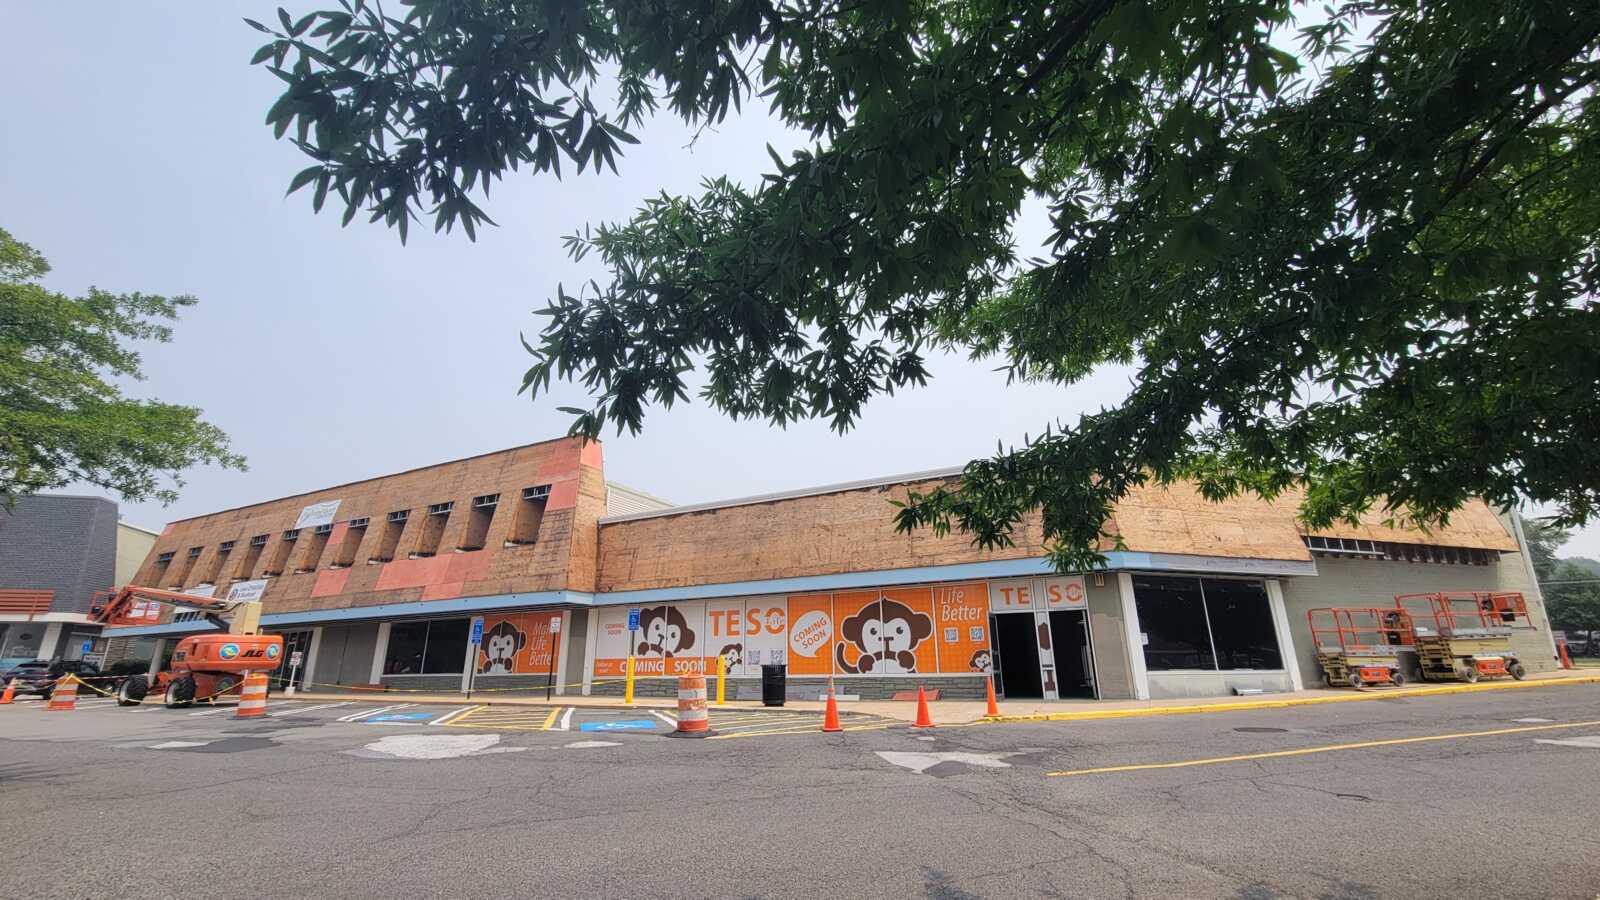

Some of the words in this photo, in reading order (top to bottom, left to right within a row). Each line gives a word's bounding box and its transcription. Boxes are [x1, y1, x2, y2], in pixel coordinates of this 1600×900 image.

[940, 587, 963, 604] Life
[942, 603, 982, 622] Better
[793, 616, 827, 643] COMING
[531, 637, 547, 652] Life
[802, 630, 826, 649] SOON
[242, 650, 265, 658] JLG
[528, 651, 552, 666] Bette
[619, 660, 664, 673] CMING
